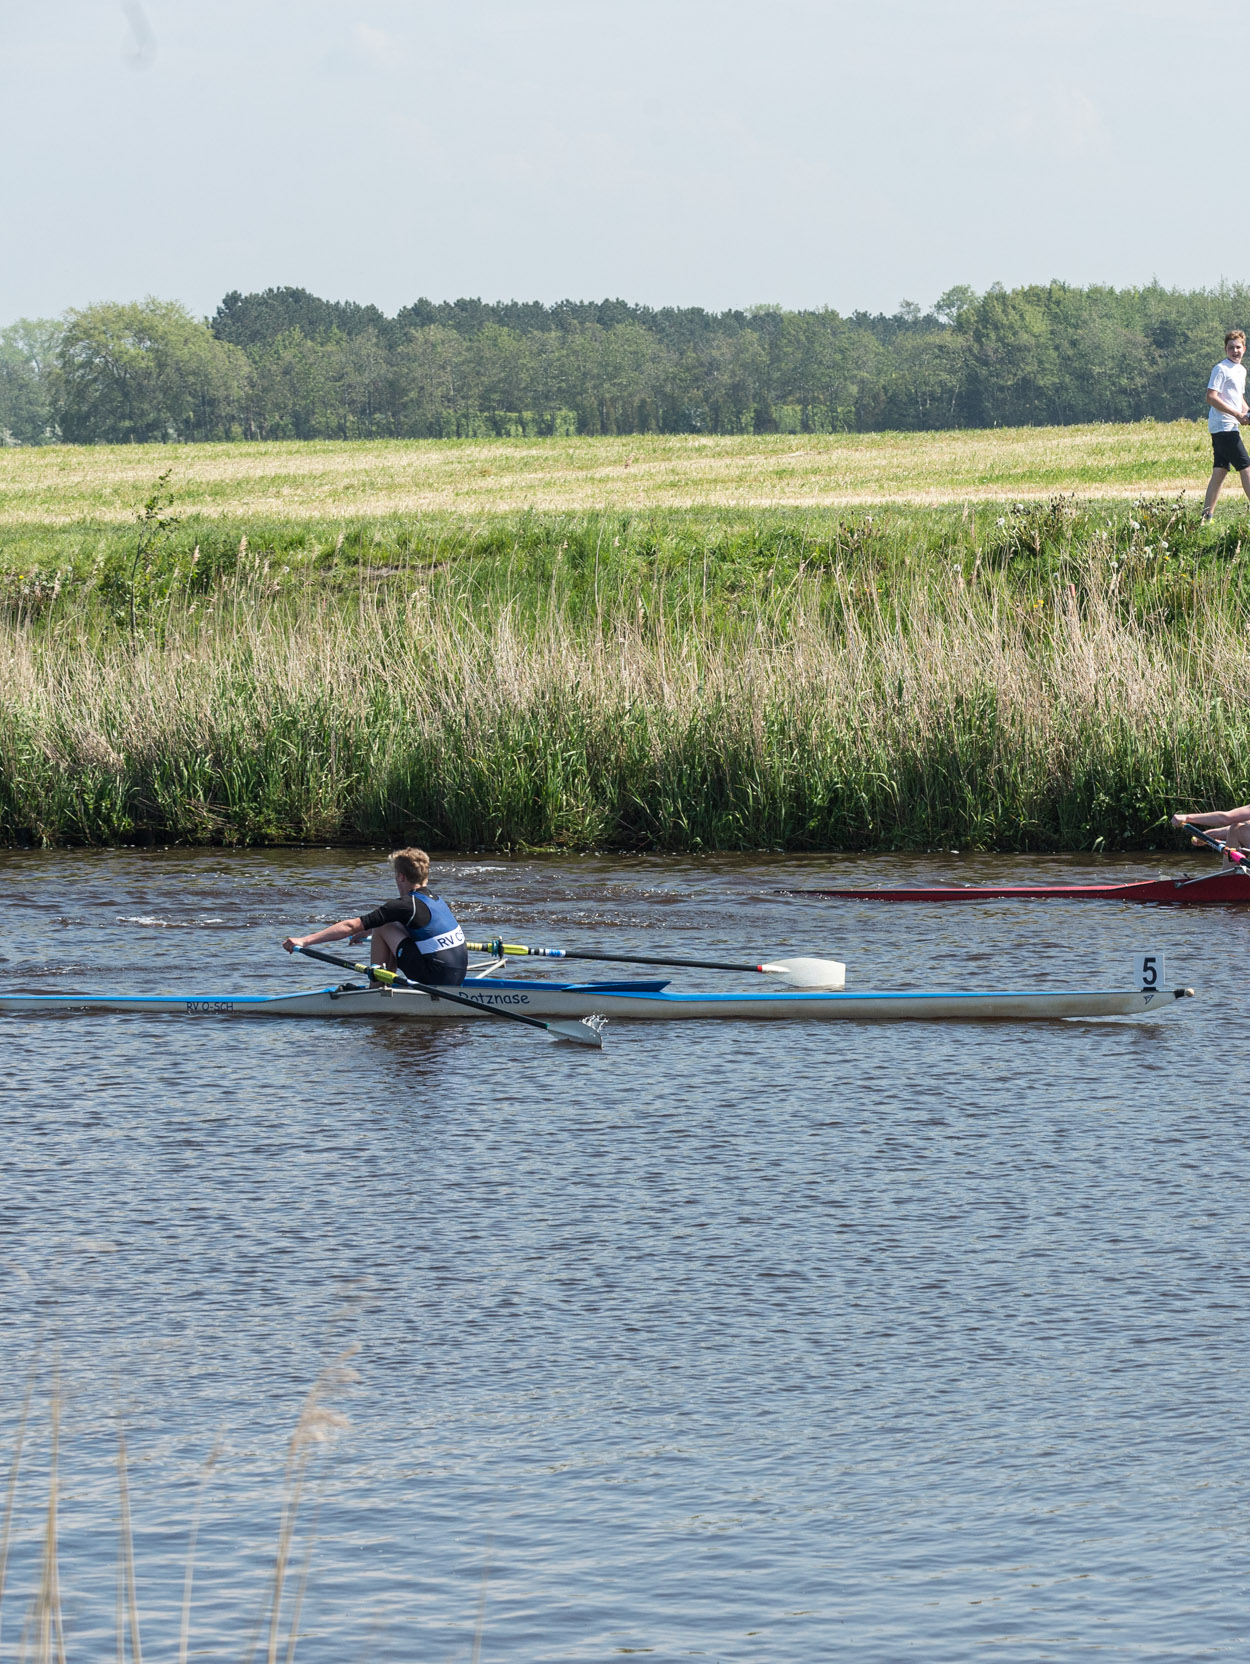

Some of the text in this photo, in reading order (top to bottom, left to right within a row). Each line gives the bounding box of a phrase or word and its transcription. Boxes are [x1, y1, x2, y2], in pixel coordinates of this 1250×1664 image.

[437, 935, 454, 948] RV
[1142, 957, 1157, 985] 5
[186, 1001, 234, 1011] RV O-SCH
